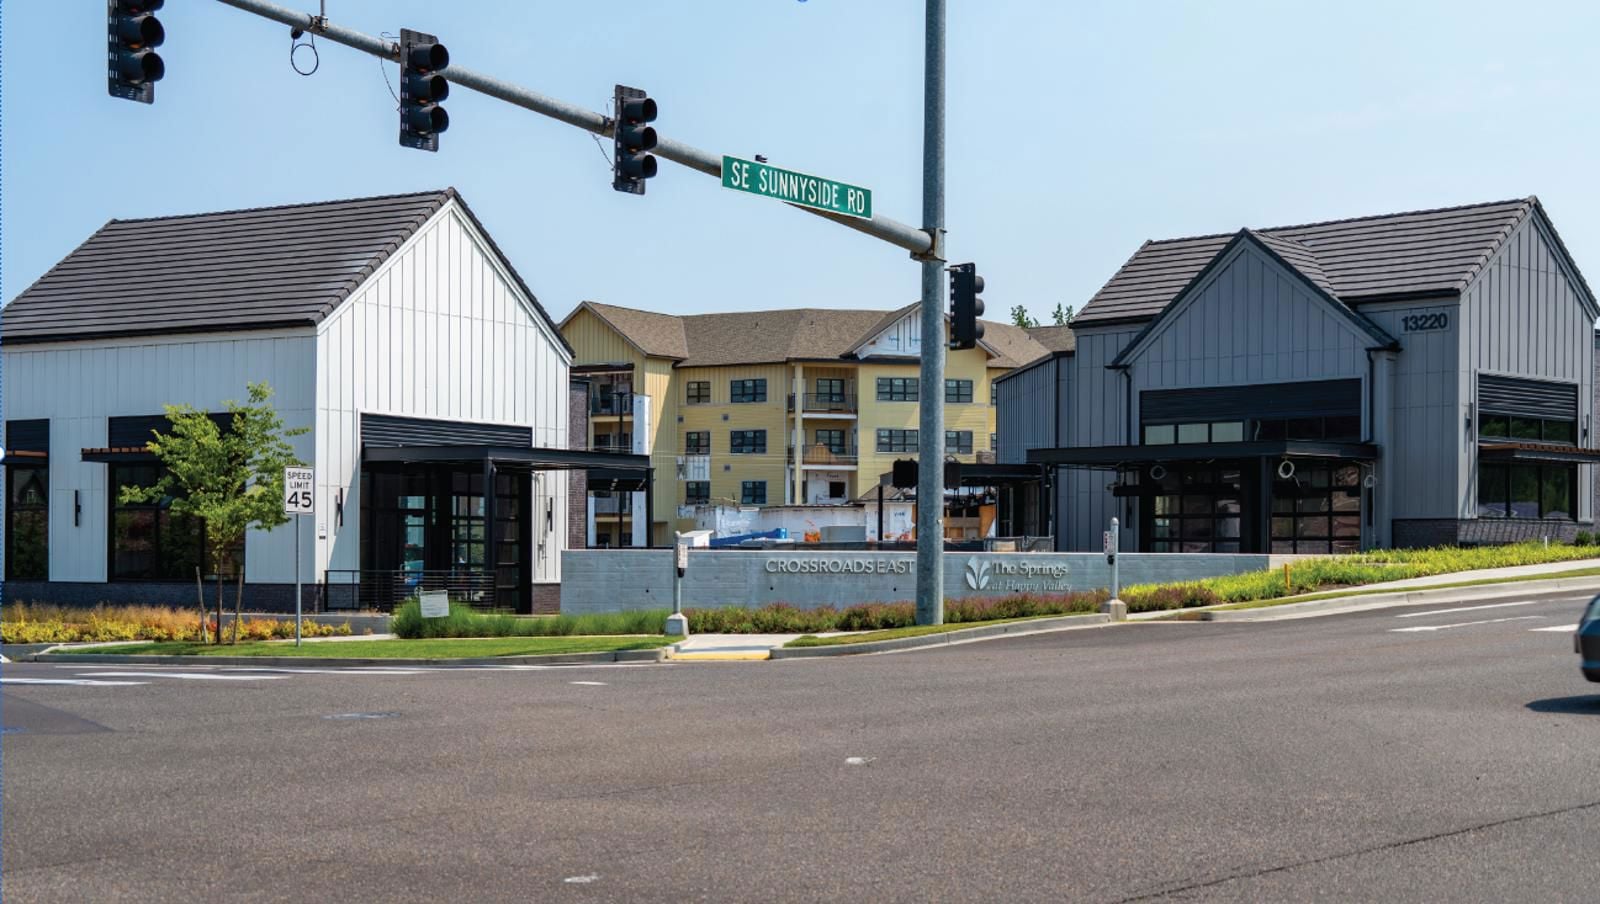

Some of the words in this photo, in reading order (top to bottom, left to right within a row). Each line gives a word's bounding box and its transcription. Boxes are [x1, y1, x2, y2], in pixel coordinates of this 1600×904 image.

[731, 162, 750, 188] SE
[759, 169, 840, 208] SUNNYSIDE
[847, 189, 865, 214] RD
[1401, 312, 1448, 332] 13220
[287, 472, 312, 480] SPEED
[289, 481, 309, 489] LIMIT
[287, 491, 312, 508] 45
[765, 559, 874, 573] CROSSROADS
[876, 559, 916, 574] EAST
[992, 560, 1017, 574] The
[1020, 560, 1068, 578] Springs
[992, 582, 1002, 591] at
[1005, 580, 1039, 592] Happy
[1042, 580, 1072, 592] Valley
